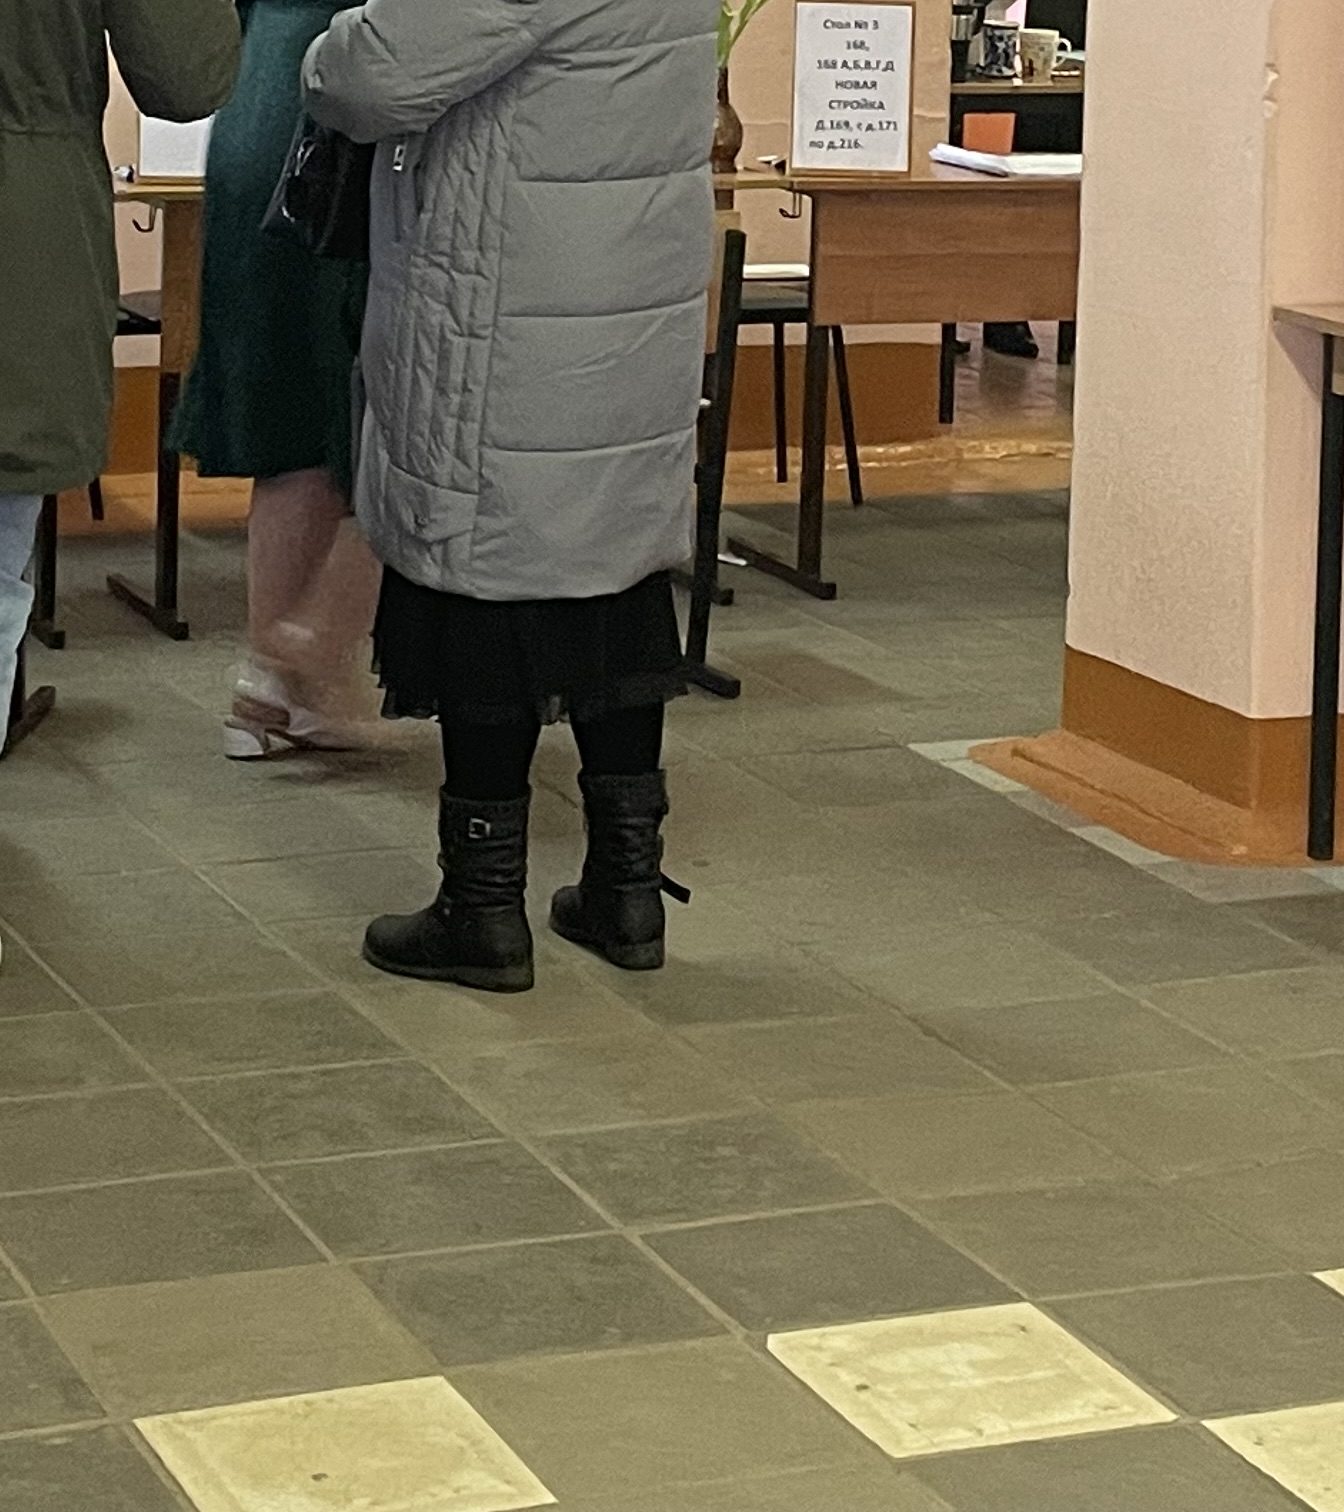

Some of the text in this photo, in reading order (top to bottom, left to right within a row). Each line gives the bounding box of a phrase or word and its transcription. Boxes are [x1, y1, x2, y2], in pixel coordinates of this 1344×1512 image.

[823, 18, 851, 30] Стол
[872, 19, 879, 30] 3
[846, 39, 870, 52] 168,
[835, 80, 877, 90] НОВАЯ
[828, 97, 886, 111] СТРОЙКА
